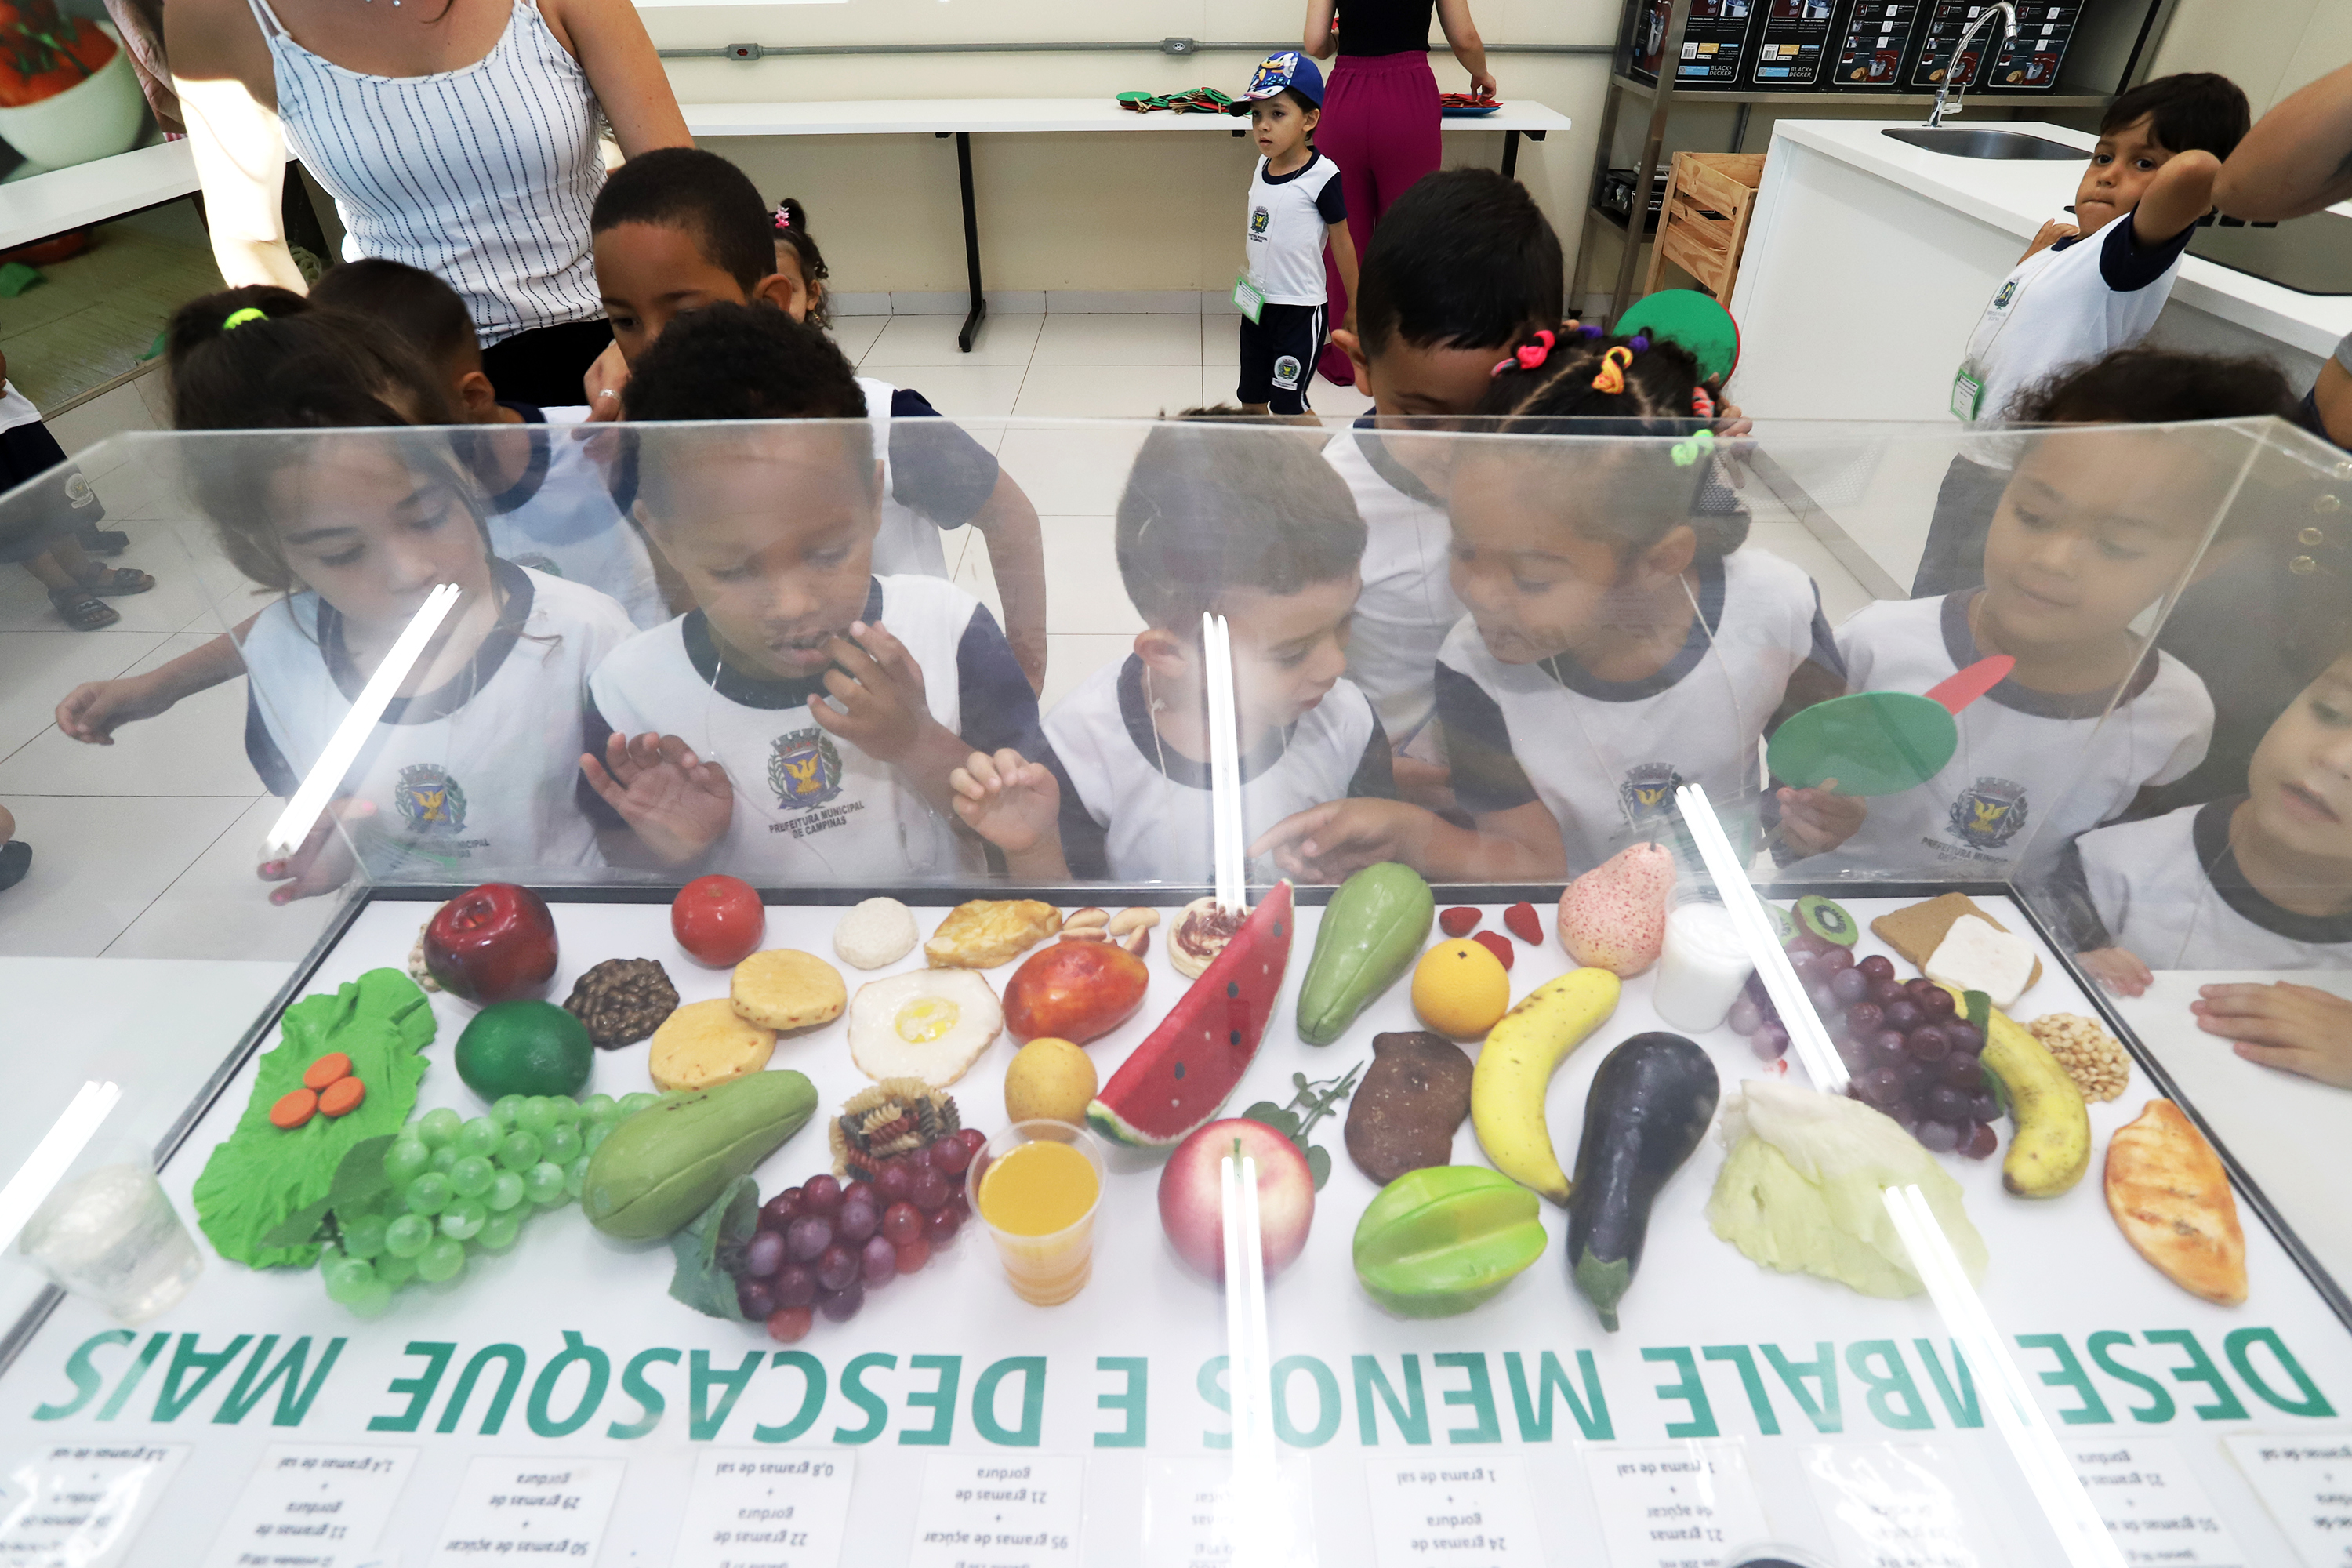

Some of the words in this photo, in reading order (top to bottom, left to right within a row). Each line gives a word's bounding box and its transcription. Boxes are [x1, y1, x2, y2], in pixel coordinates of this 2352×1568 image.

[768, 813, 819, 833] PREFEITURA
[820, 800, 865, 820] MUNICIPAL
[792, 829, 804, 839] DE
[805, 815, 847, 835] CAMPINAS
[31, 1328, 348, 1427] MAIS
[1640, 1327, 2338, 1438] DESEMBALE
[367, 1330, 1047, 1446] DESCASQUE
[1094, 1356, 1148, 1447] E
[1196, 1350, 1616, 1447] MENOS
[321, 1457, 373, 1472] gramas
[714, 1462, 736, 1477] sal
[738, 1462, 757, 1477] de
[760, 1459, 810, 1475] gramas
[812, 1461, 834, 1478] 0,8
[1616, 1463, 1637, 1479] sal
[1639, 1463, 1657, 1477] de
[515, 1472, 572, 1488] gordura
[976, 1466, 1032, 1483] gordura
[1396, 1472, 1417, 1486] sal
[1419, 1472, 1437, 1486] de
[1440, 1468, 1485, 1483] grama
[1488, 1470, 1496, 1483] 1
[488, 1495, 508, 1510] de
[510, 1493, 562, 1507] gramas
[955, 1490, 973, 1504] de
[976, 1488, 1028, 1502] gramas
[1031, 1491, 1048, 1504] 21
[285, 1501, 344, 1516] gordura
[738, 1506, 795, 1523] gordura
[1647, 1504, 1691, 1520] açúcar
[1426, 1512, 1483, 1530] gordura
[276, 1522, 330, 1537] gramas
[735, 1529, 789, 1544] gramas
[1649, 1526, 1702, 1541] gramas
[1706, 1529, 1724, 1543] 21
[515, 1538, 571, 1554] gramas
[713, 1532, 732, 1546] de
[790, 1533, 808, 1548] 22
[923, 1530, 971, 1547] açúcar
[973, 1533, 993, 1548] de
[996, 1533, 1048, 1547] gramas
[1051, 1536, 1069, 1550] 95
[1432, 1535, 1485, 1550] gramas
[1489, 1537, 1507, 1552] 24
[444, 1537, 494, 1556] açúcar
[494, 1541, 514, 1556] de
[569, 1541, 590, 1557] 50
[1411, 1539, 1429, 1554] de
